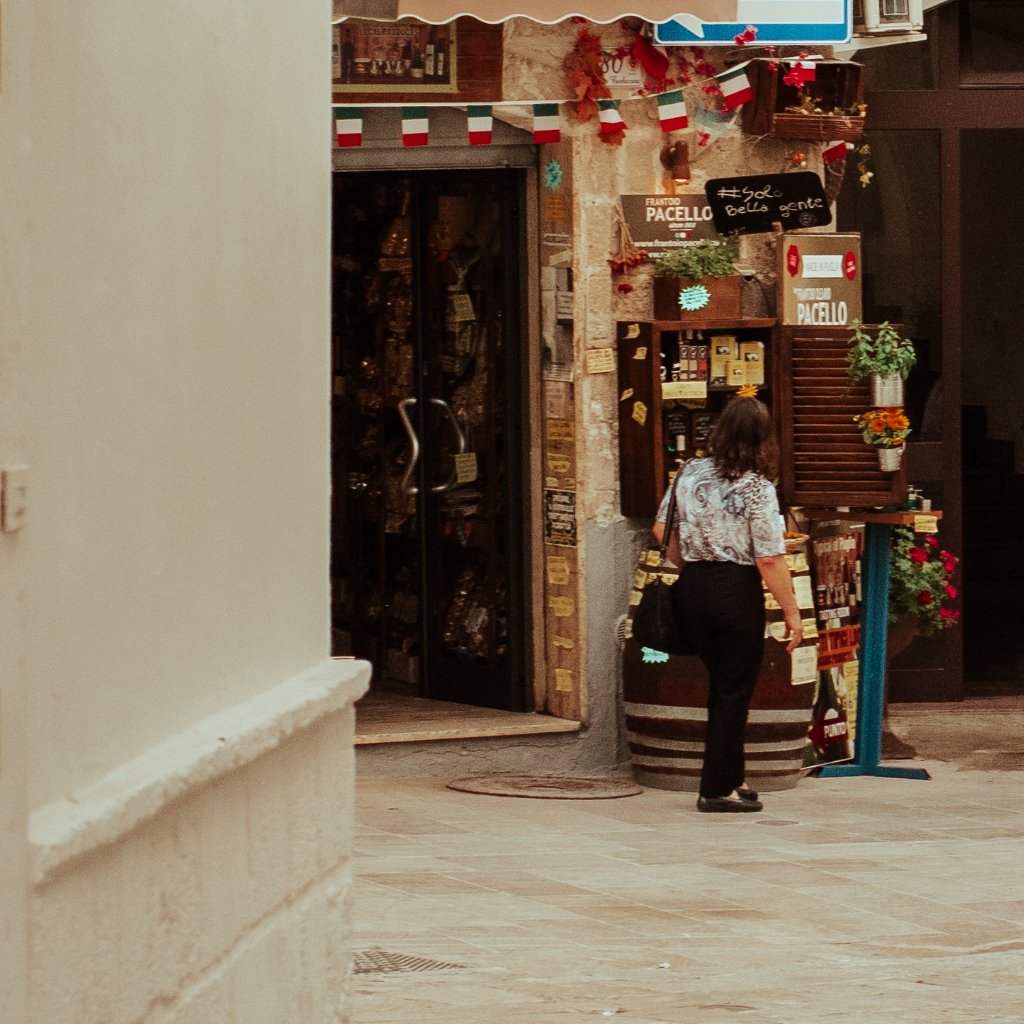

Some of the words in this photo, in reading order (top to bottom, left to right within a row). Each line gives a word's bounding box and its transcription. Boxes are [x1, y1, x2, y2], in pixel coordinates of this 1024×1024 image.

[646, 205, 714, 223] PACELLO
[779, 196, 824, 218] gente
[797, 300, 848, 326] PACELLO
